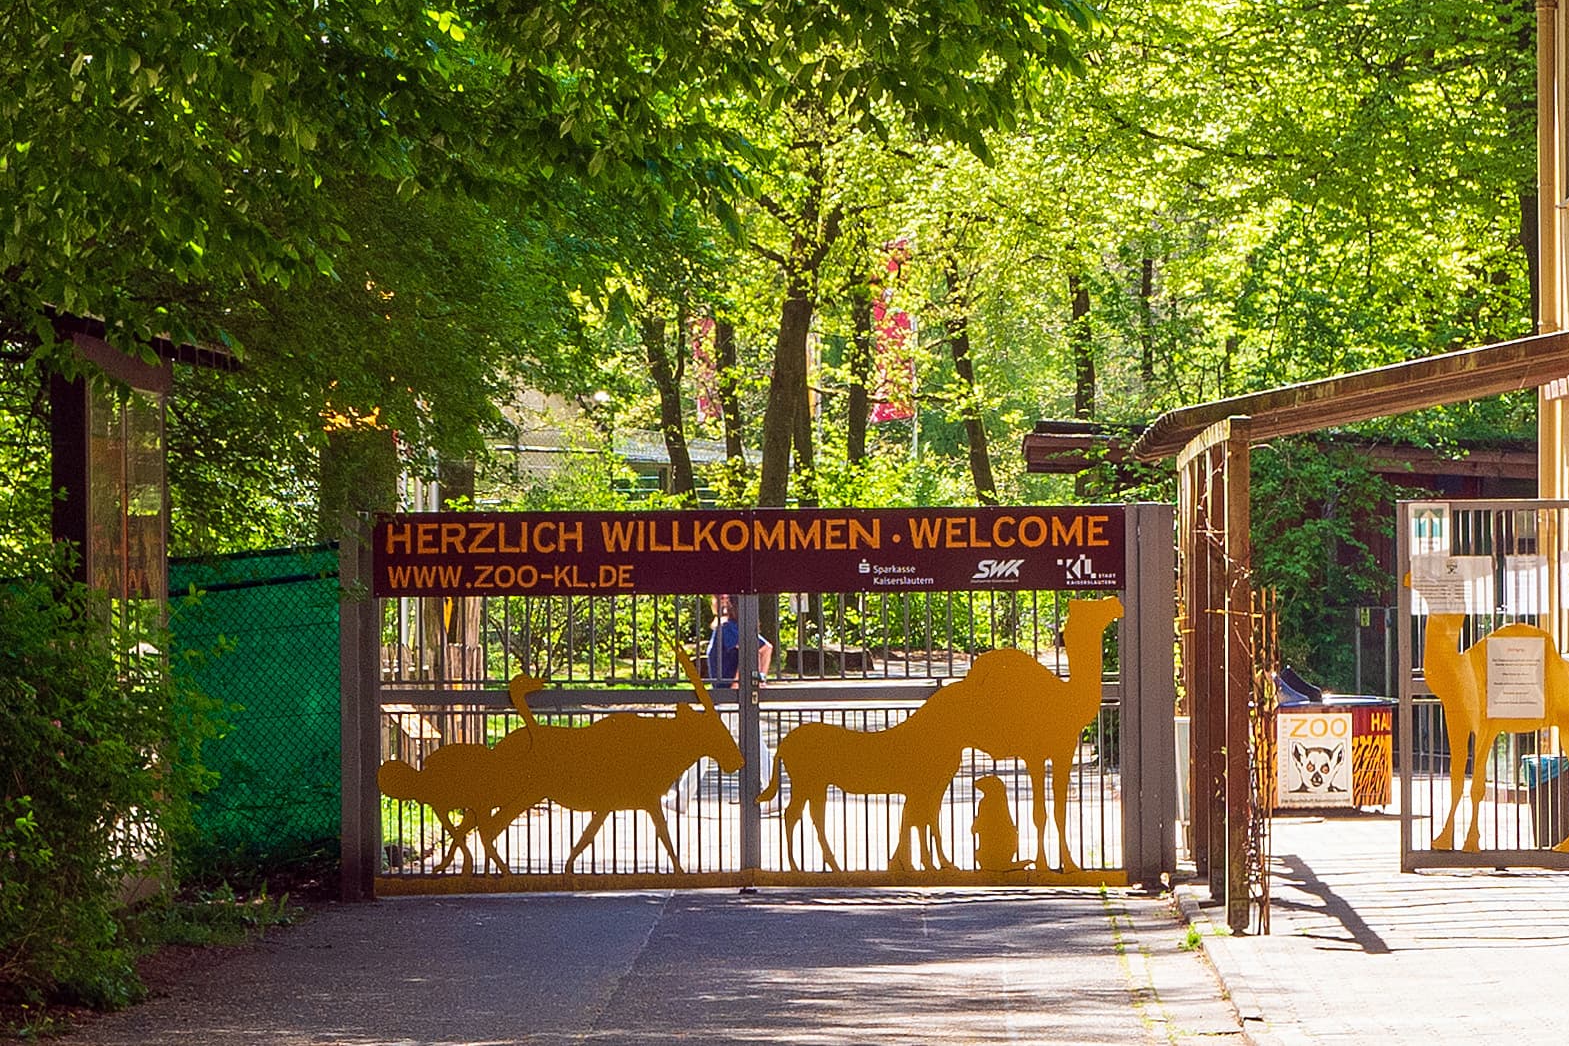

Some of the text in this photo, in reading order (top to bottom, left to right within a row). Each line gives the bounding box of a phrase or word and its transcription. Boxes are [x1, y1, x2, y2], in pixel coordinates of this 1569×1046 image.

[387, 515, 1110, 555] HERZLICH WILLKOMMEN WELCOME
[387, 565, 635, 589] WWW.ZOO-KL.DE
[872, 565, 916, 576] Sparkasse
[971, 559, 1025, 579] SWK
[873, 576, 934, 585] Kaiserslautern
[1289, 717, 1348, 738] ZOO
